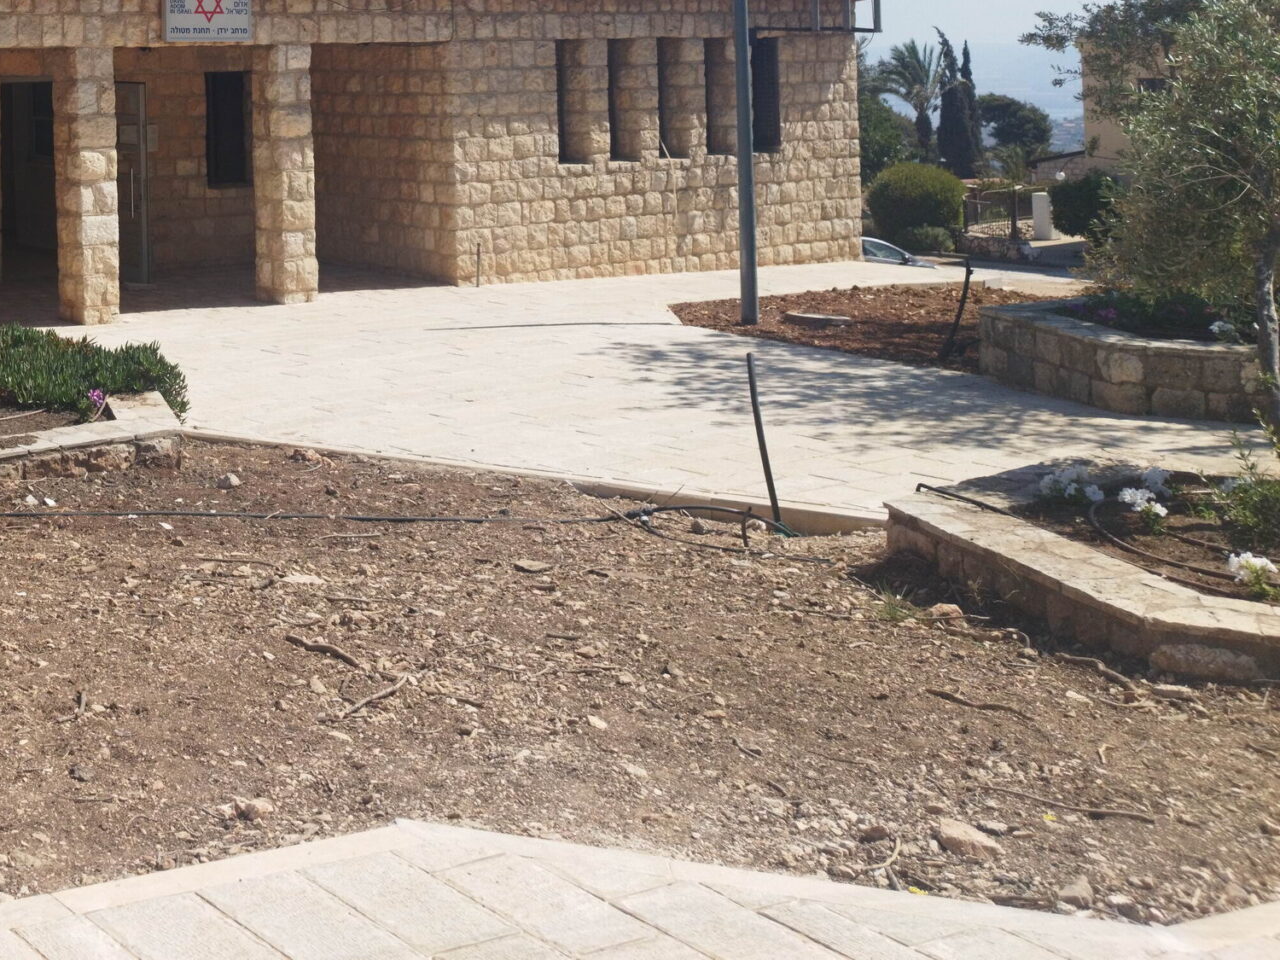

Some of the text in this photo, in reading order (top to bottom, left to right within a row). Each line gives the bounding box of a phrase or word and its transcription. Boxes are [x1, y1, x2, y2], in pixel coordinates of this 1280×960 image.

[225, 7, 248, 15] בישראל
[170, 26, 191, 34] מטולה
[217, 27, 228, 35] ירדן
